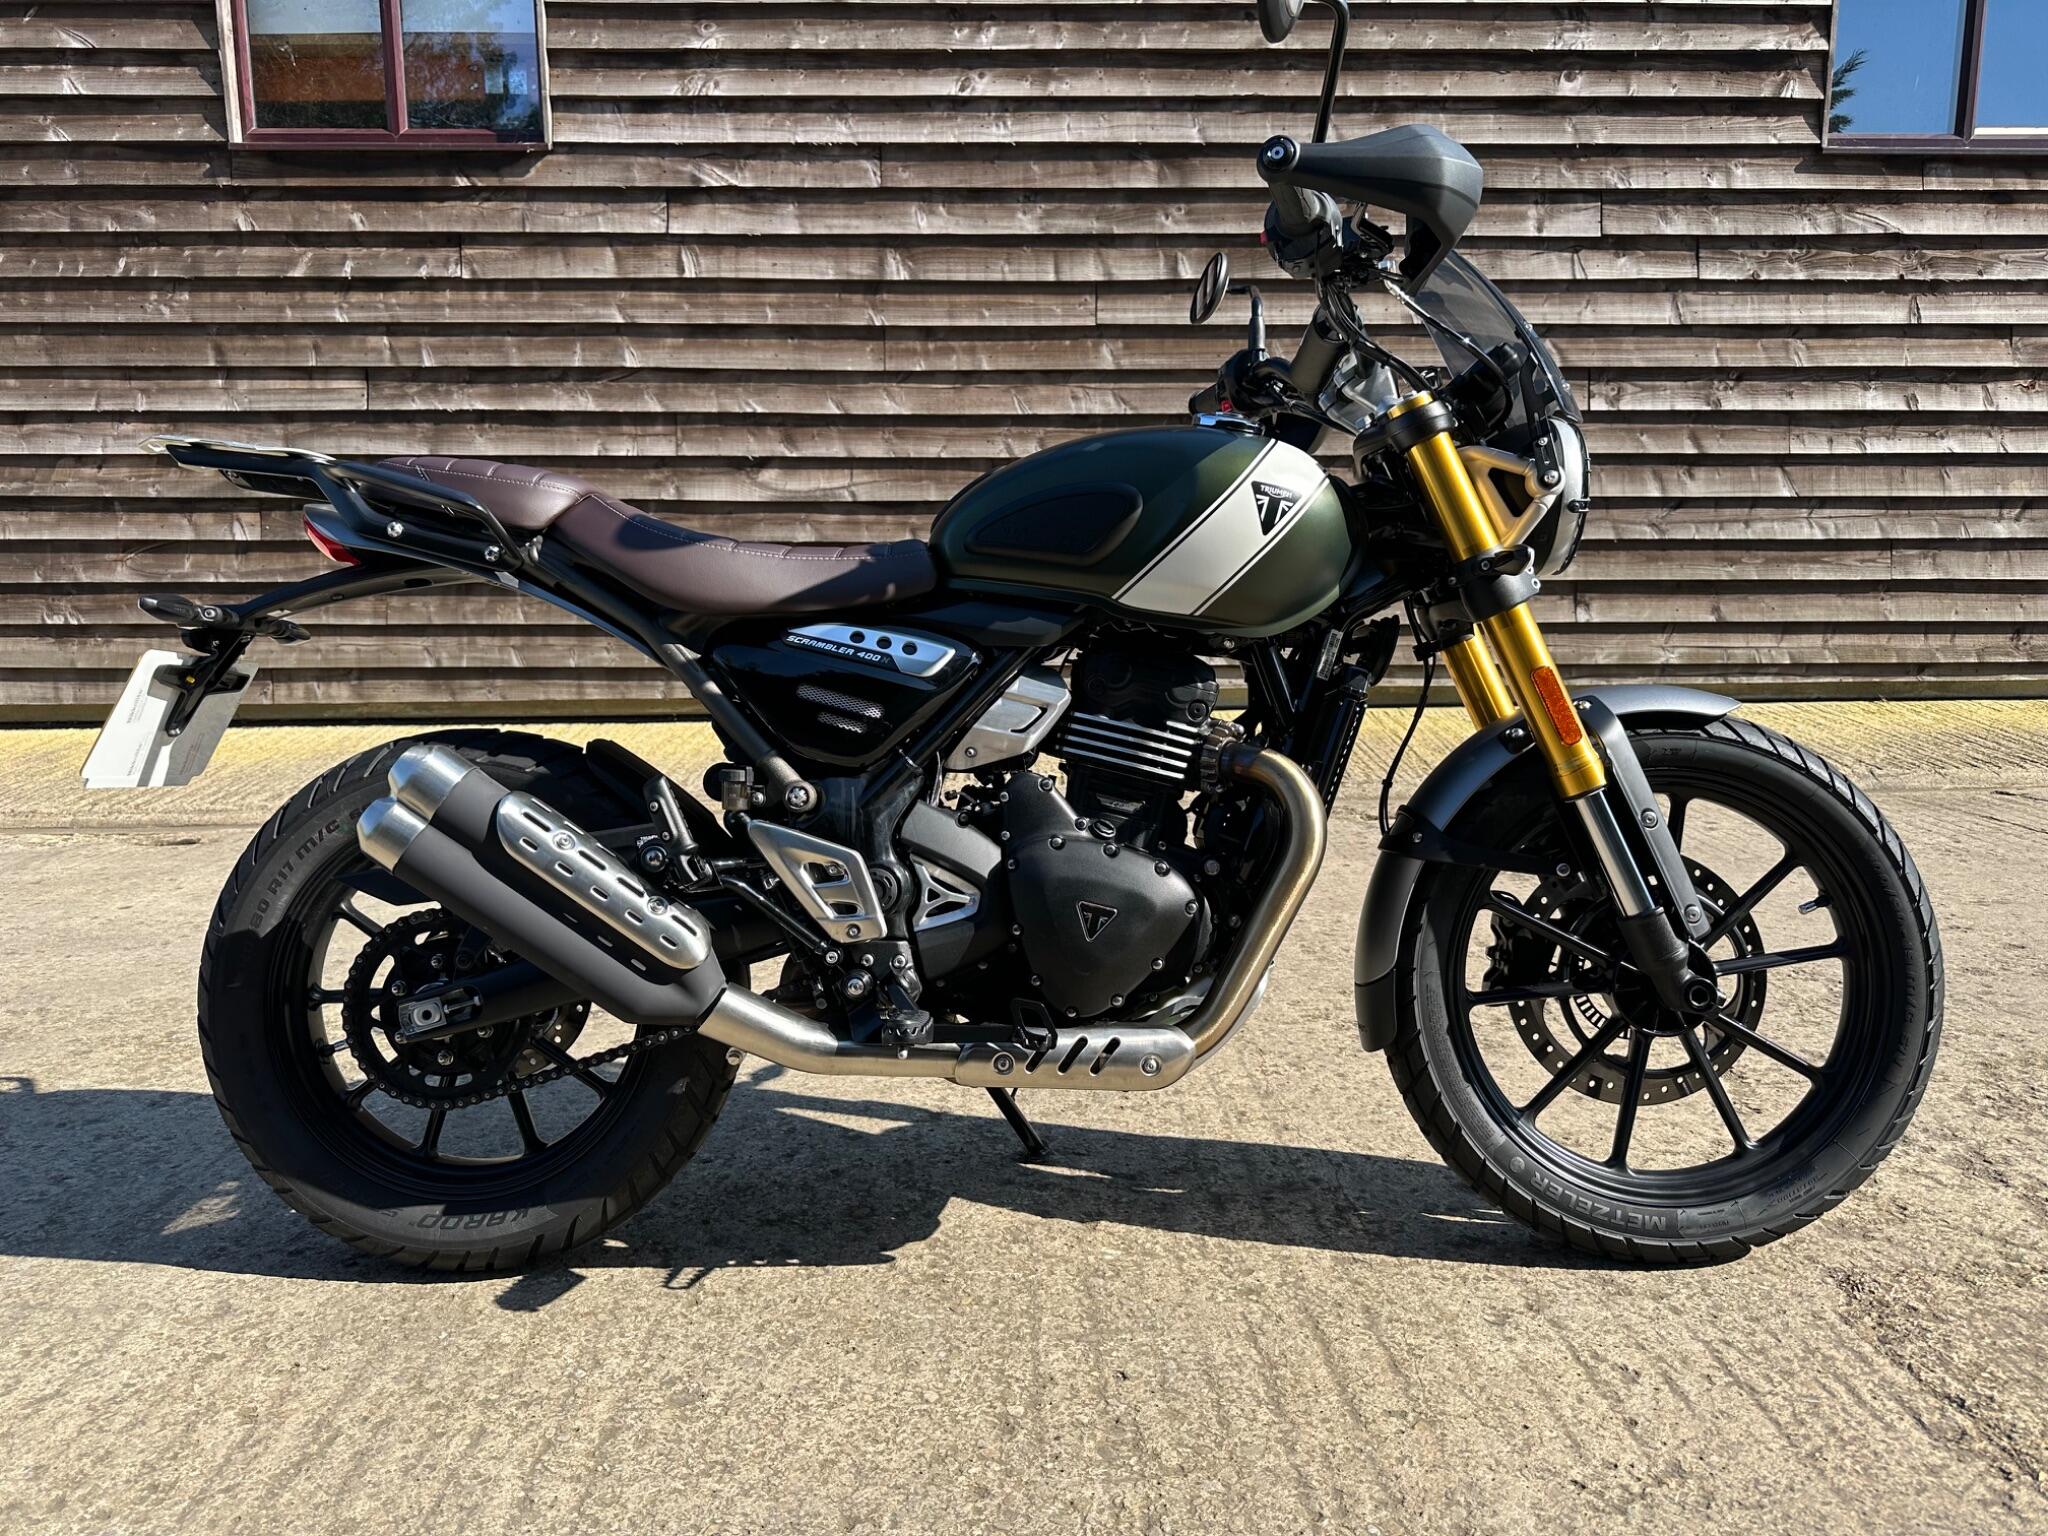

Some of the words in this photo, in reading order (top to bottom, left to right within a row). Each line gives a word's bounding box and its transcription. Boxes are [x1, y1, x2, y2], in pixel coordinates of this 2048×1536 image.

[1261, 485, 1293, 499] TRIUMPH
[786, 635, 855, 656] SCRAMBLER
[267, 859, 294, 896] R17
[1530, 1174, 1667, 1231] METZELER
